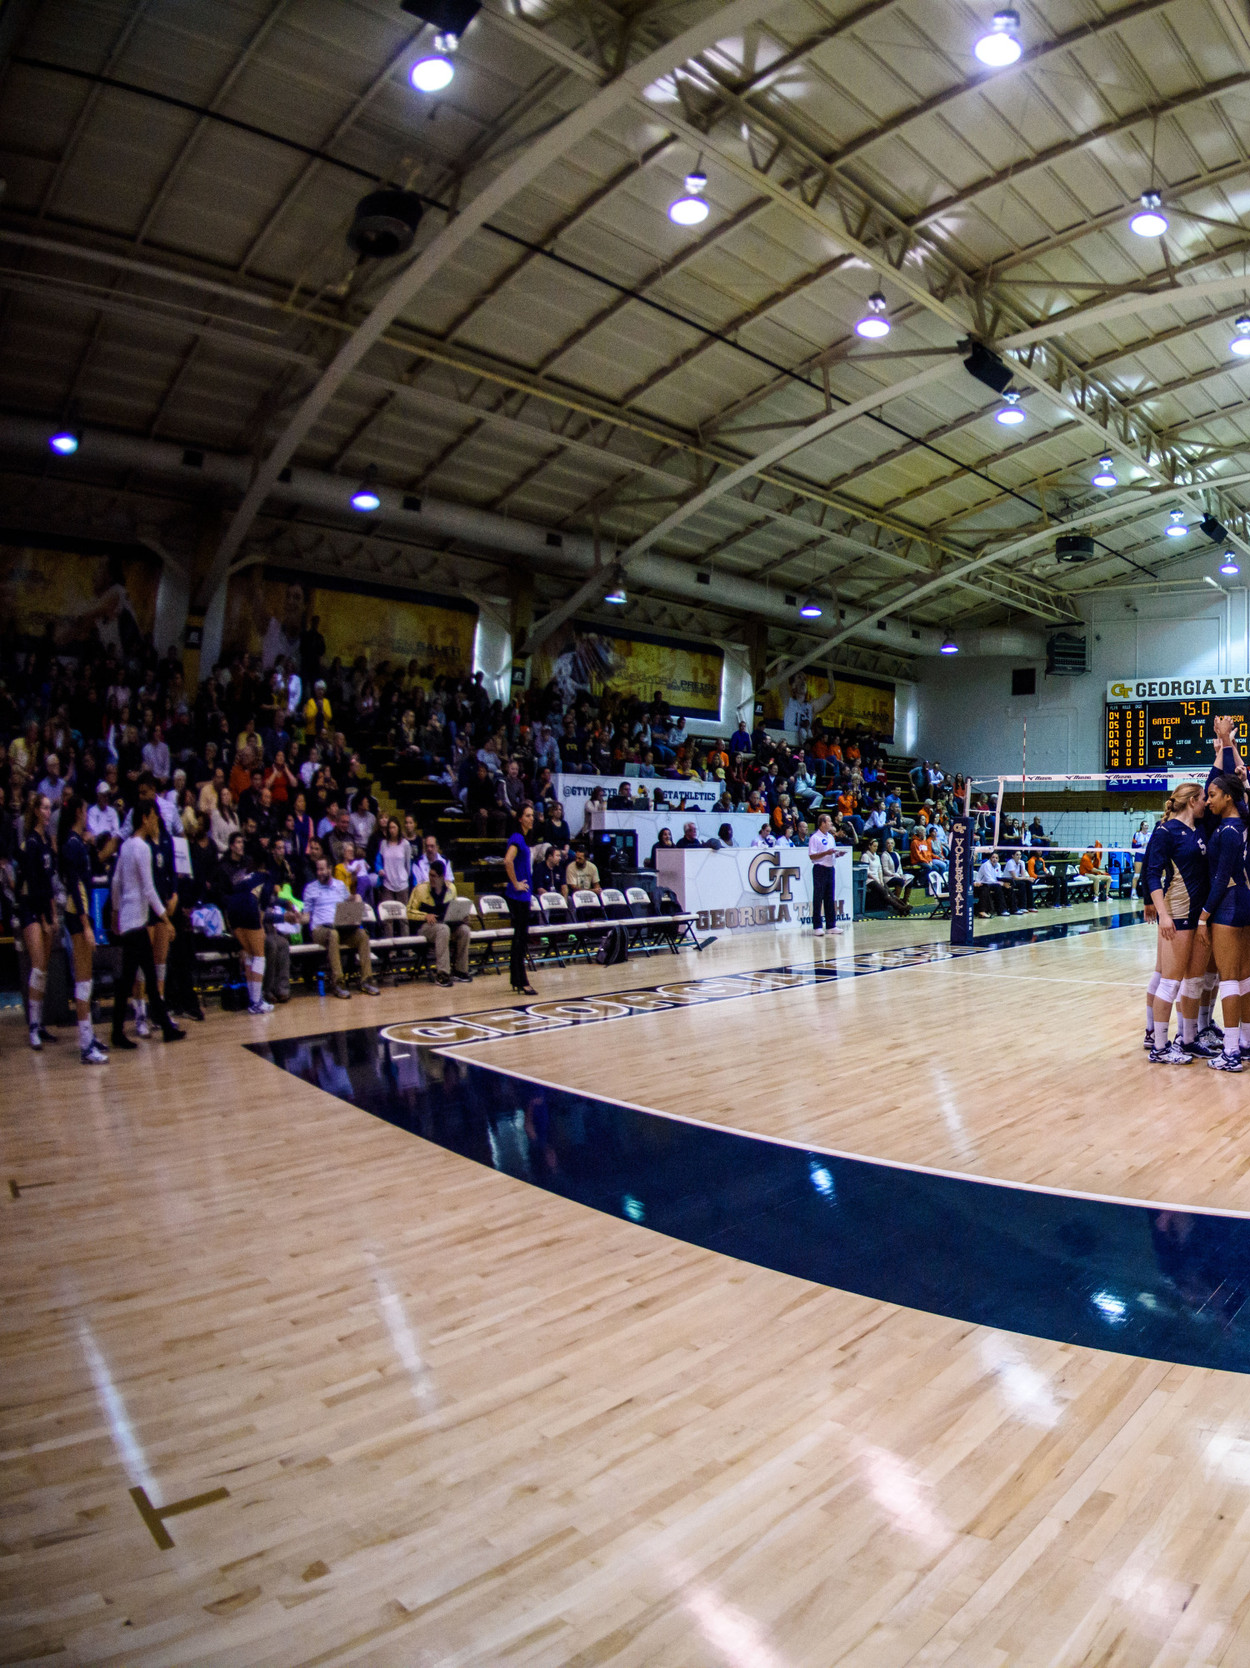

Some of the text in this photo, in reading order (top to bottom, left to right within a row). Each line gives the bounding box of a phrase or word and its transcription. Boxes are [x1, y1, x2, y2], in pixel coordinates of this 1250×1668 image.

[1111, 683, 1133, 698] GT
[1135, 679, 1216, 697] GEORGIA
[1180, 701, 1210, 716] 75.0
[1109, 711, 1119, 720] 04
[1109, 721, 1119, 729] 05
[1239, 723, 1248, 737] 0
[1109, 730, 1119, 738] 07
[1163, 726, 1171, 740] 0
[1109, 739, 1119, 748] 09
[1111, 749, 1119, 757] 14
[1158, 748, 1165, 759] 0
[1240, 745, 1248, 757] 0
[1111, 758, 1119, 766] 18
[662, 790, 716, 801] GTATHLETICS
[953, 823, 967, 834] GT
[1197, 838, 1207, 855] 5
[748, 852, 801, 901] GT
[954, 838, 965, 916] VOLLEYBALL
[696, 900, 845, 931] GEORGIA TH
[380, 971, 840, 1045] GEORGIA
